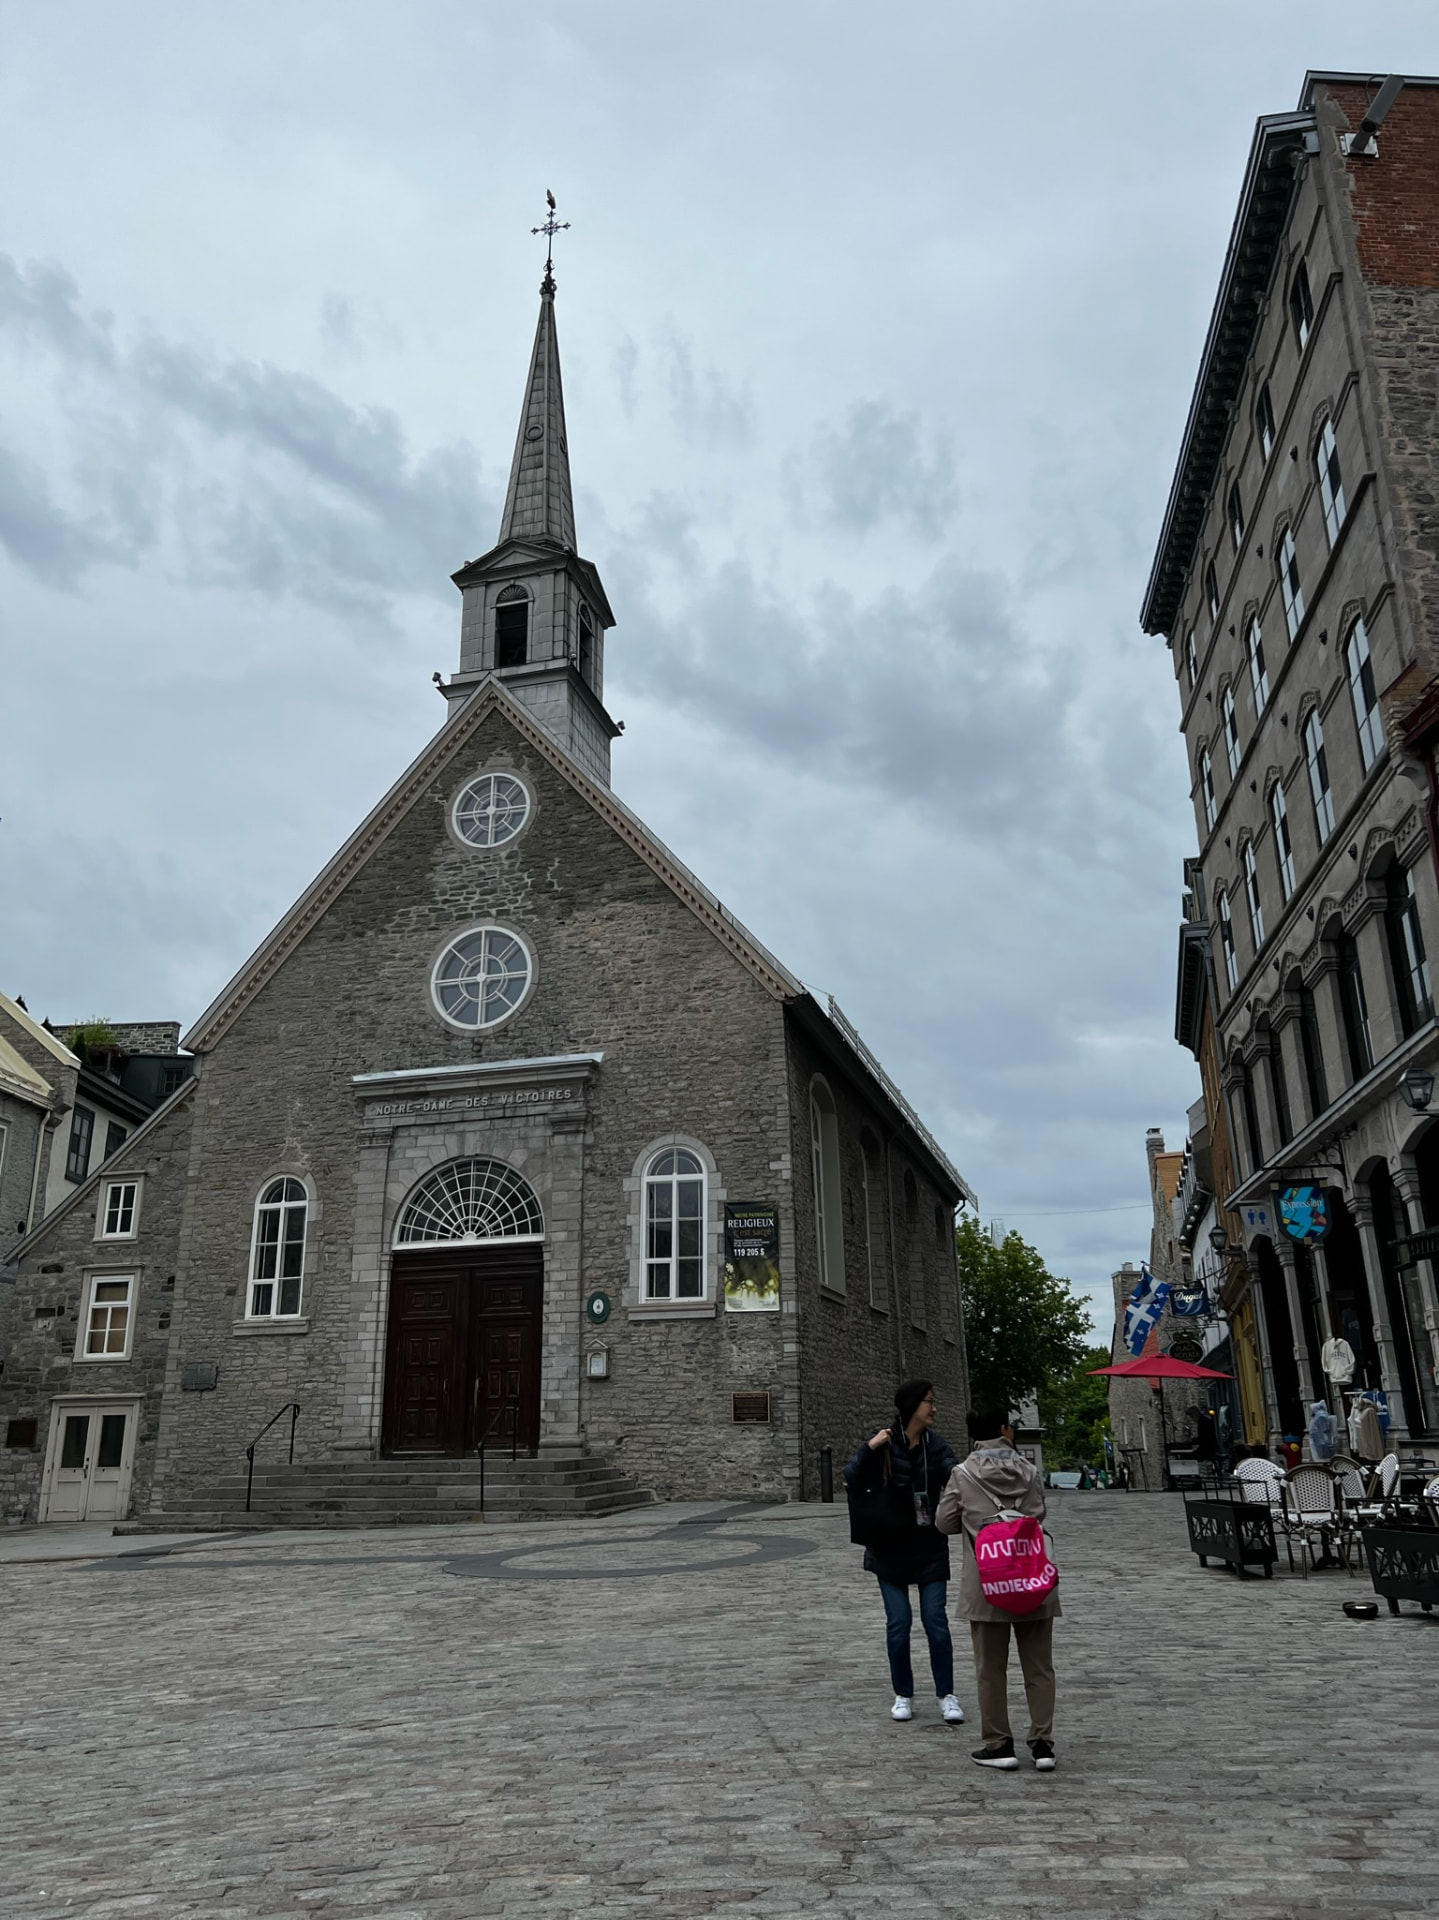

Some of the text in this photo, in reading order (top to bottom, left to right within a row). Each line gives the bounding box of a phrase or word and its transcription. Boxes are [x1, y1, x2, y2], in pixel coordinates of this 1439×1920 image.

[375, 1089, 572, 1116] NOTRE-DAME DES VICTOIRES
[727, 1218, 774, 1228] RELIGIEUX
[733, 1248, 746, 1256] 119
[746, 1247, 759, 1256] 205
[1173, 1290, 1204, 1303] Dugal
[982, 1563, 1056, 1596] INDIEGOGO
